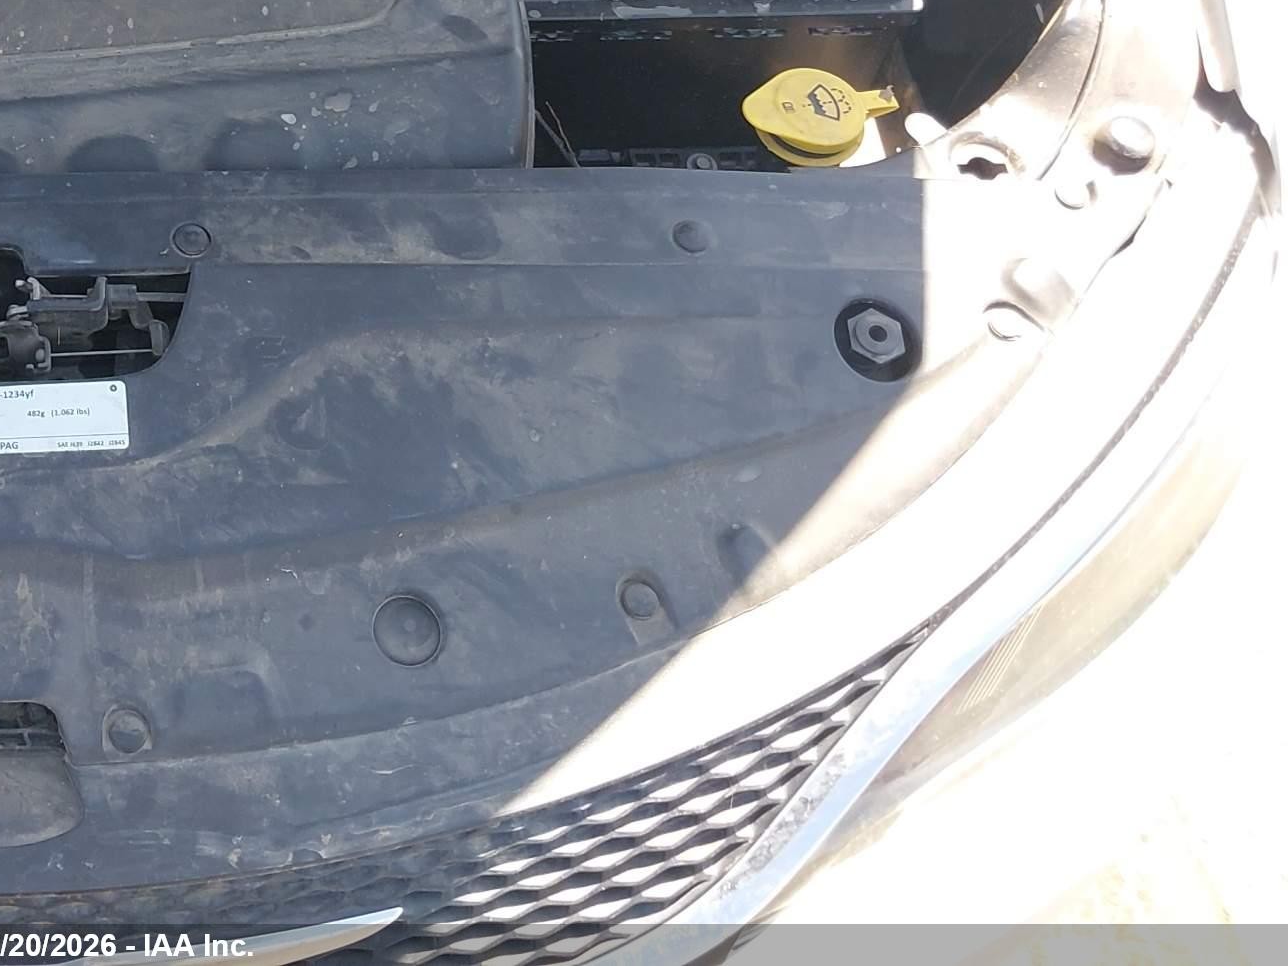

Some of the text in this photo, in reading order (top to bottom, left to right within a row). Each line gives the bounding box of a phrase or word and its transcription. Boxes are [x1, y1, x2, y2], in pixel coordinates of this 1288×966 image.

[26, 407, 91, 418] 482g (1.062 lbs)
[0, 440, 20, 451] PAG
